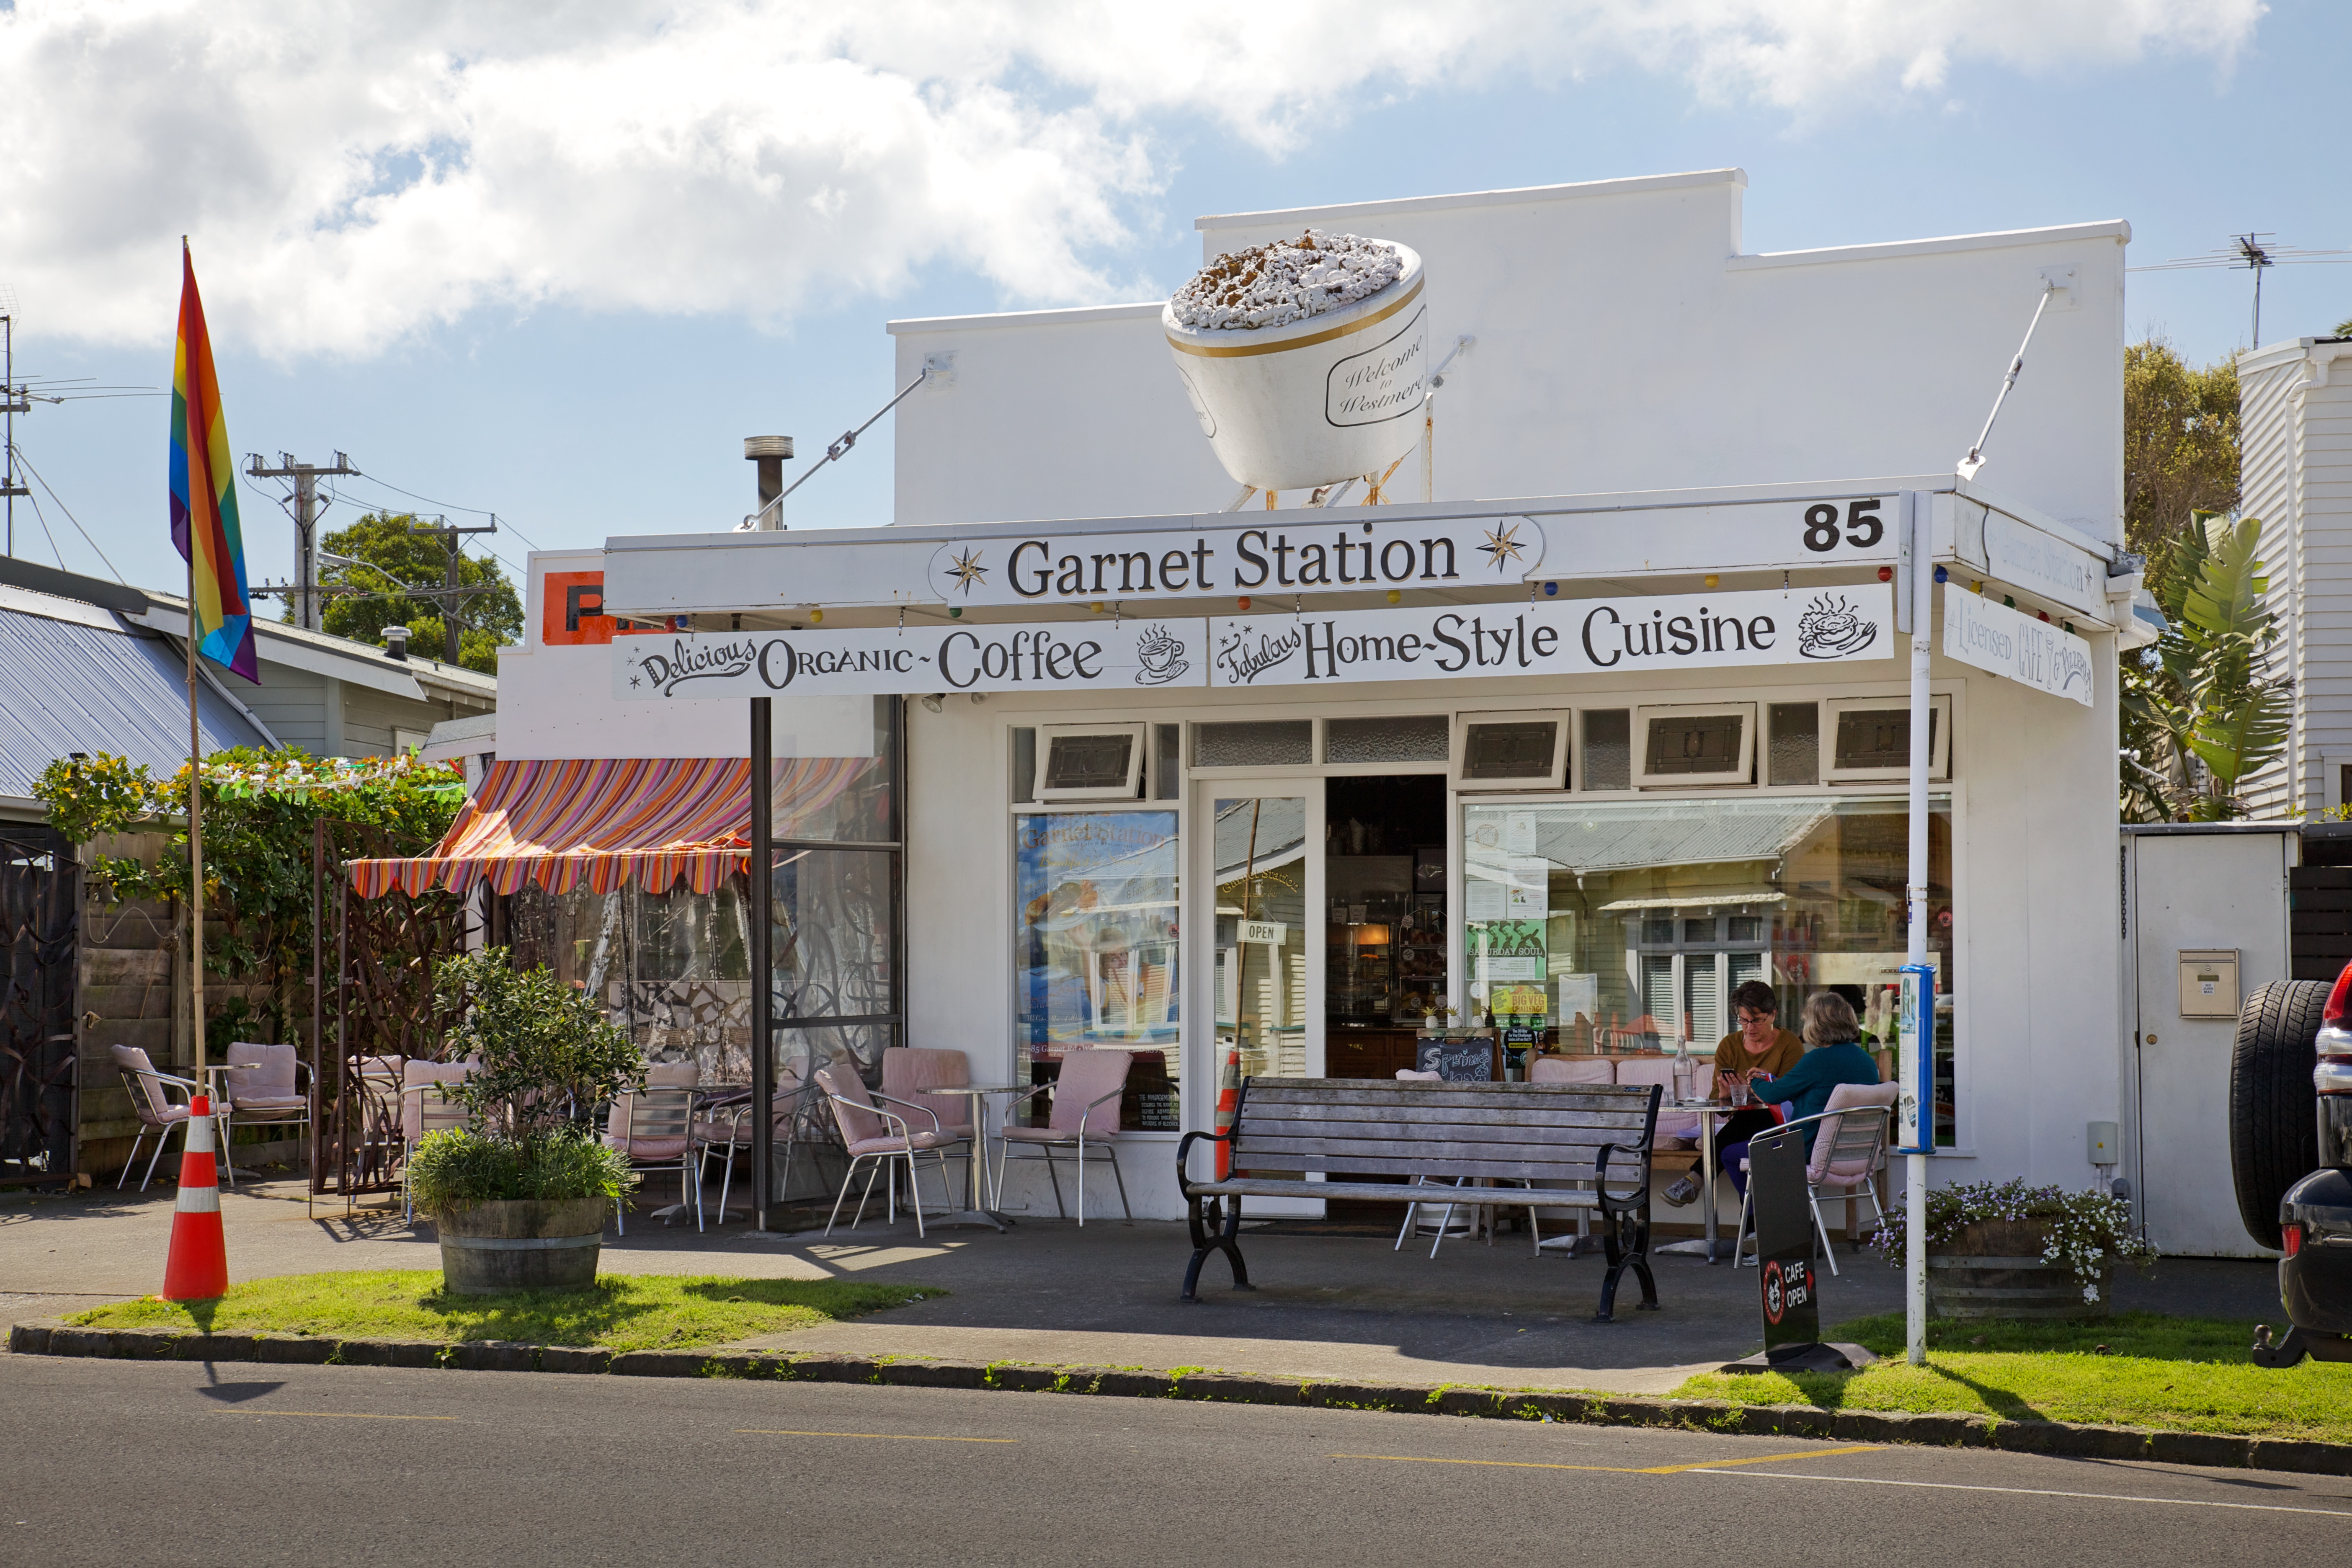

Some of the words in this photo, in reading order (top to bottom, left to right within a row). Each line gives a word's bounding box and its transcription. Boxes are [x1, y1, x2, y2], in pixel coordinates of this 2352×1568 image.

[1345, 335, 1422, 389] Welcome
[1340, 375, 1424, 414] Westmere
[1380, 379, 1392, 390] to
[1803, 499, 1884, 552] 85
[1008, 538, 1214, 598] Garnet
[1235, 522, 1460, 588] Station
[1217, 627, 1301, 684] Fabulous
[1581, 606, 1776, 667] Cuisine
[2018, 623, 2043, 683] CAFE
[639, 637, 757, 691] Delicious
[758, 639, 913, 690] ORGANIC
[938, 631, 1103, 688] Coffee
[1023, 822, 1093, 849] Garnet
[1097, 821, 1166, 849] Station
[1039, 851, 1090, 870] Breakfast
[1133, 878, 1158, 897] Fabulous
[1222, 869, 1259, 893] Garnet
[1261, 867, 1300, 893] Station
[1144, 892, 1155, 902] from
[1249, 925, 1274, 939] OPEN
[1512, 995, 1527, 1006] BIG
[1528, 995, 1545, 1005] VEG
[1031, 1044, 1039, 1053] 85
[1785, 1261, 1805, 1284] CAFE
[1787, 1284, 1807, 1308] OPEN
